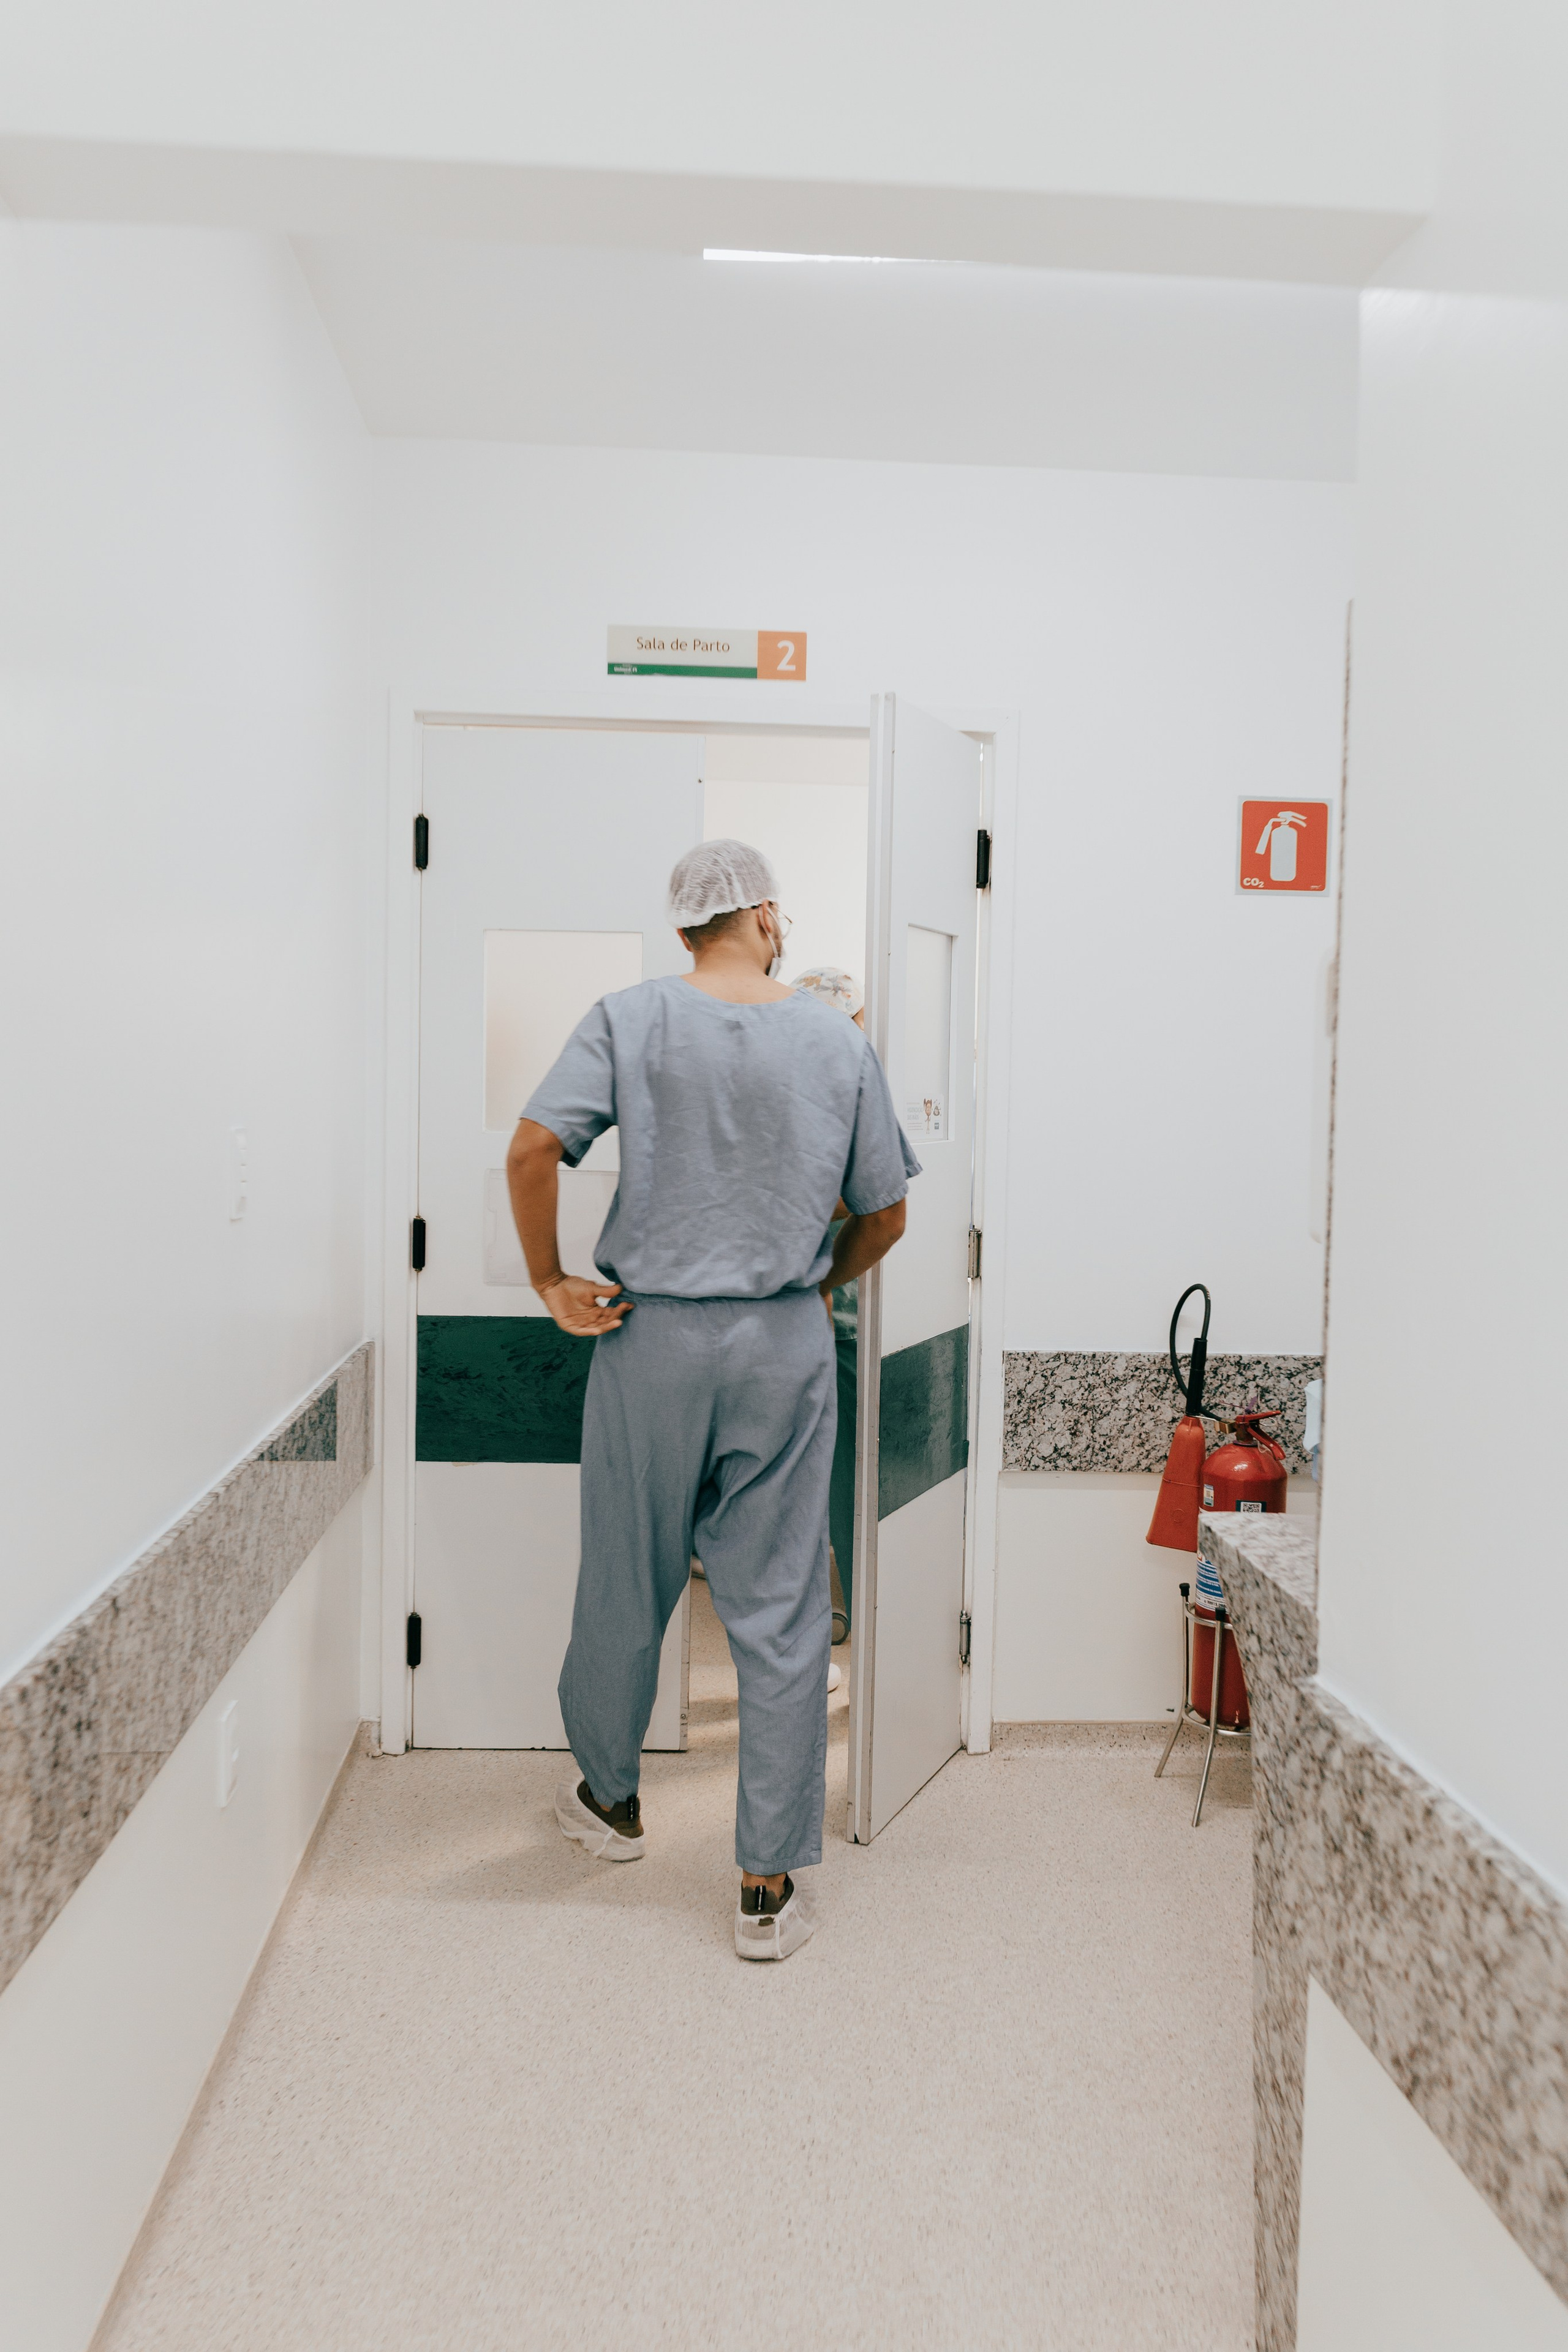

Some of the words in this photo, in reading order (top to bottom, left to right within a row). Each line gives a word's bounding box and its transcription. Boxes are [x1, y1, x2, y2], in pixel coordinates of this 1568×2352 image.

[636, 636, 665, 651] Sala
[670, 638, 688, 652] de
[693, 638, 731, 653] Parto
[776, 639, 797, 672] 2
